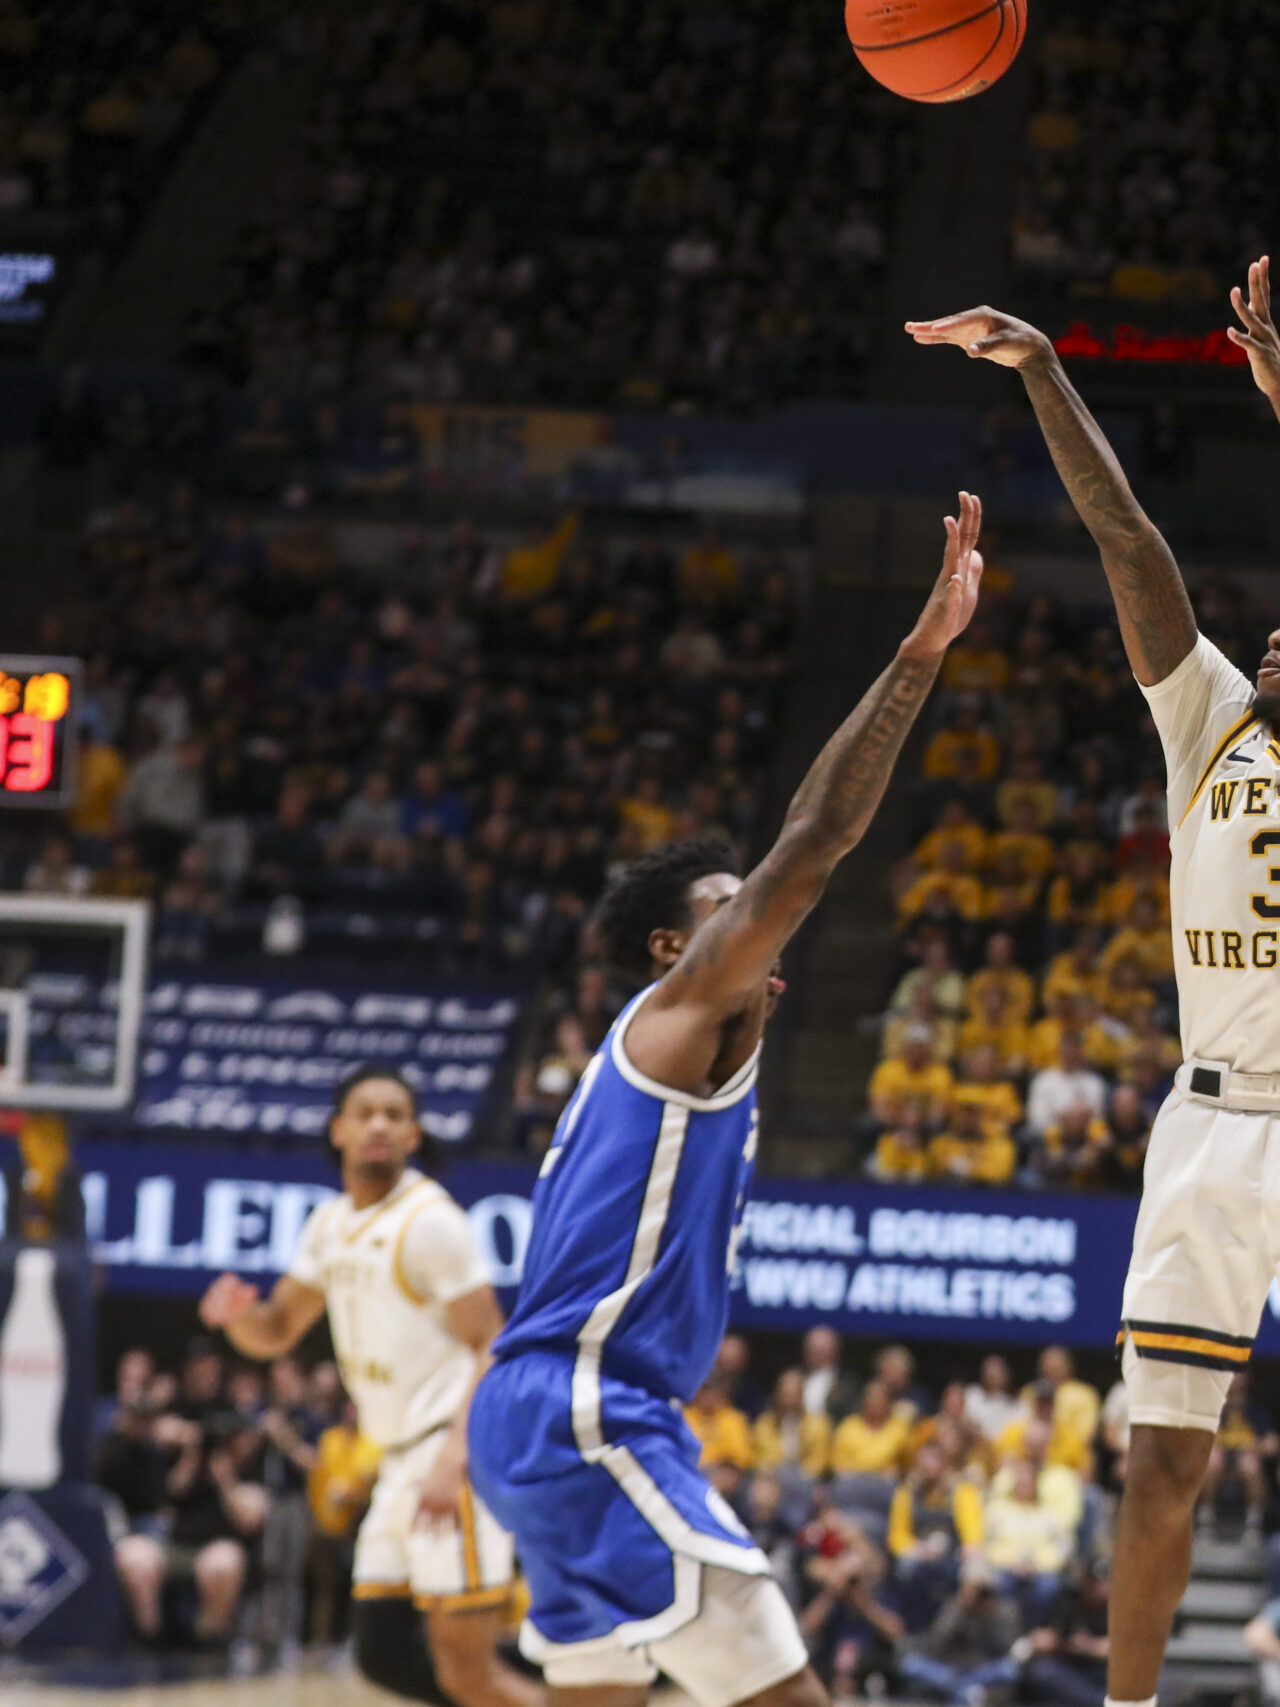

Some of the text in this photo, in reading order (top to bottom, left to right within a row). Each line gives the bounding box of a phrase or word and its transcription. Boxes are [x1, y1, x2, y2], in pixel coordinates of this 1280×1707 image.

[740, 1200, 1077, 1266] ICIAL BOURBON
[745, 1256, 848, 1311] WVU
[847, 1261, 1077, 1323] ATHLETICS
